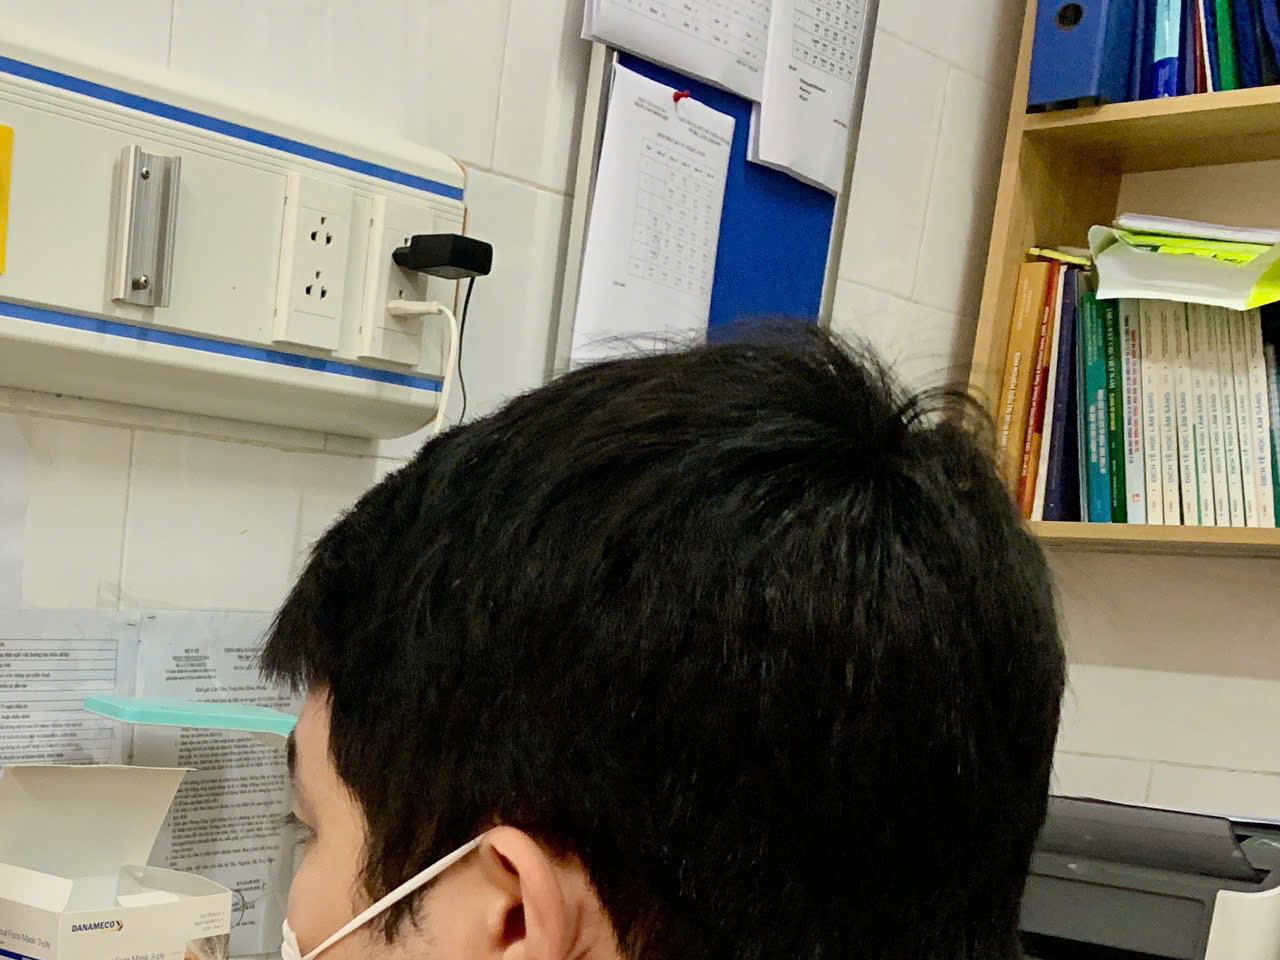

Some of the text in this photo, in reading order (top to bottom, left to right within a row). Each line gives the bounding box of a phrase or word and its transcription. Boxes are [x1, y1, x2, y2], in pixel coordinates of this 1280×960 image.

[72, 920, 115, 932] DANAMECO
[8, 929, 20, 940] Face
[22, 934, 36, 944] Mask
